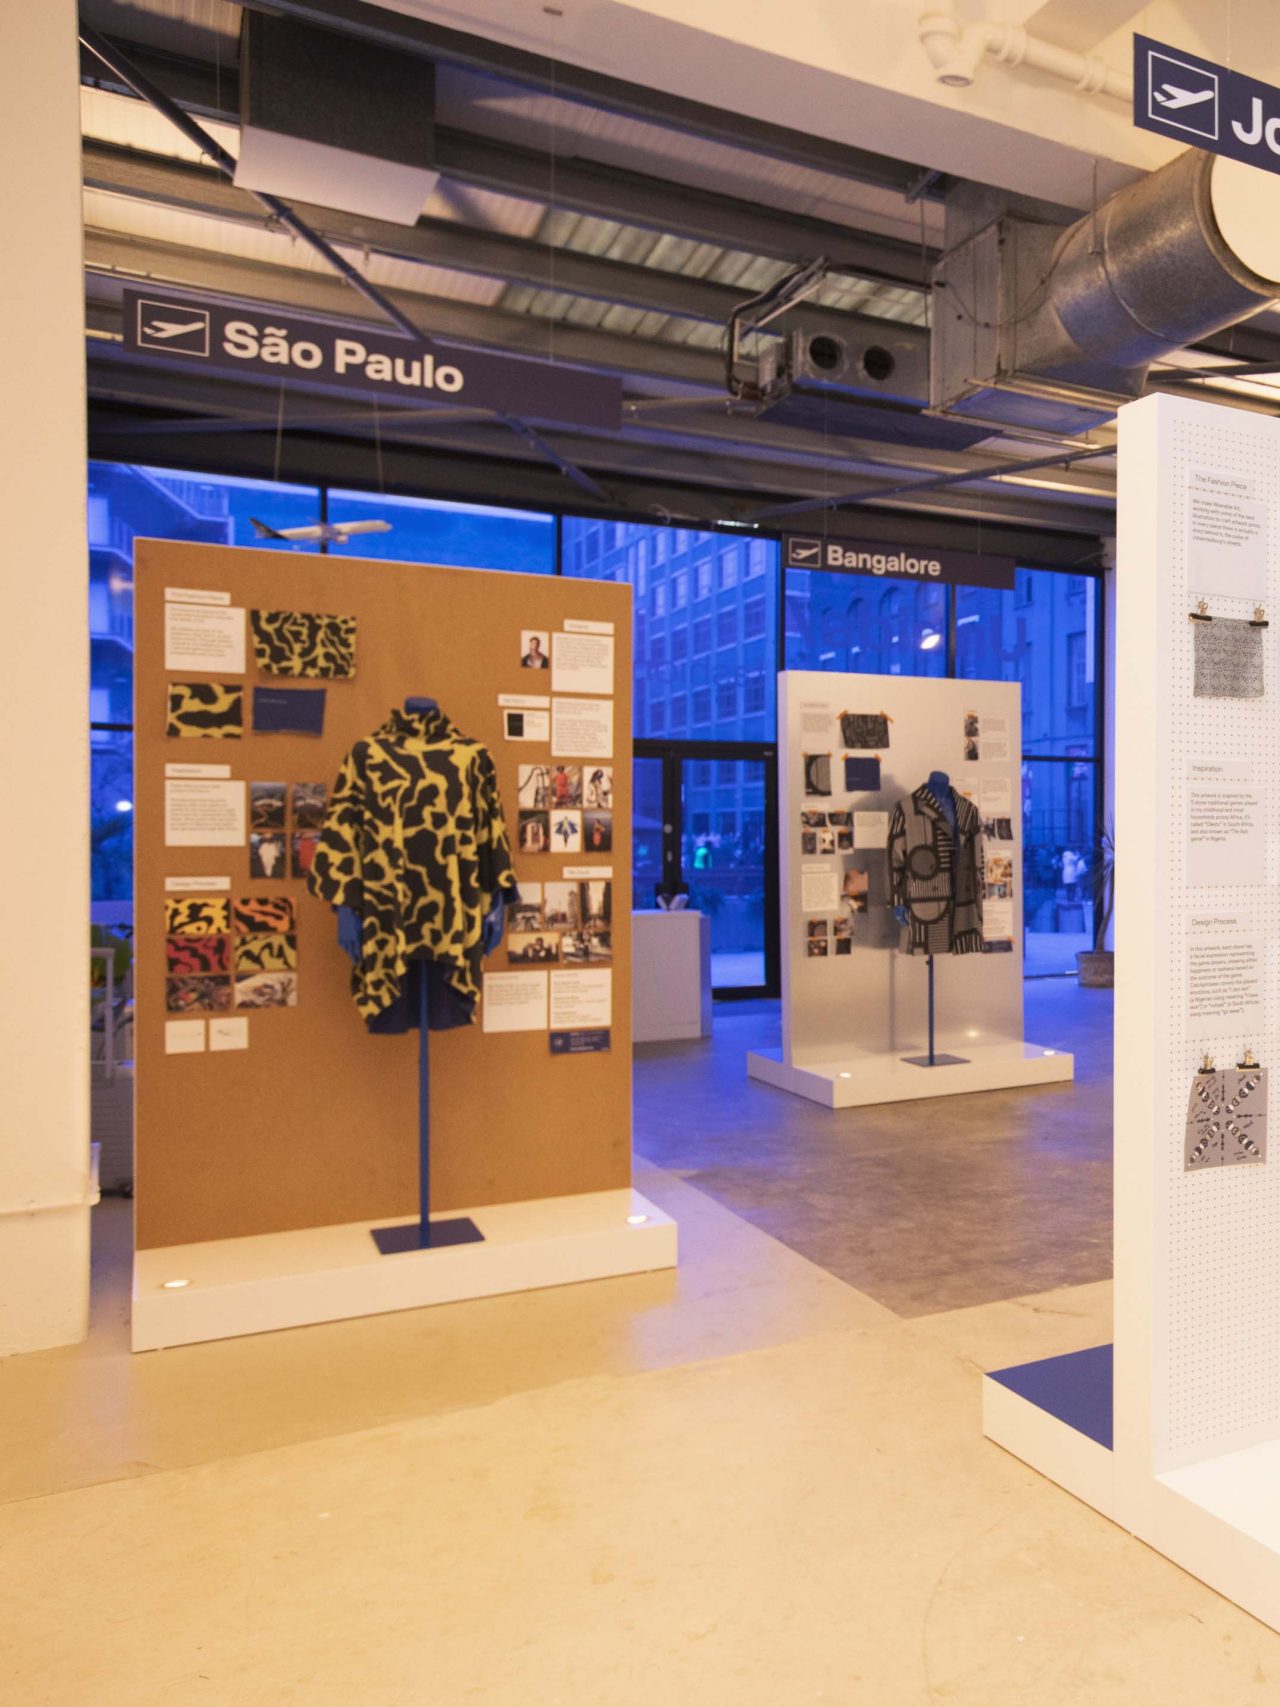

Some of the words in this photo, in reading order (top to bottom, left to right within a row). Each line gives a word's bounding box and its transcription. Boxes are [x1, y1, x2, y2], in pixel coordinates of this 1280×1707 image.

[222, 320, 323, 370] São
[334, 339, 464, 393] Paulo
[1195, 474, 1206, 483] The
[1207, 476, 1230, 487] Fashion
[1230, 480, 1247, 490] Piece
[827, 544, 941, 576] Bangalore
[1192, 764, 1223, 773] Inspiration
[1191, 919, 1212, 928] Design
[1213, 917, 1237, 925] Process
